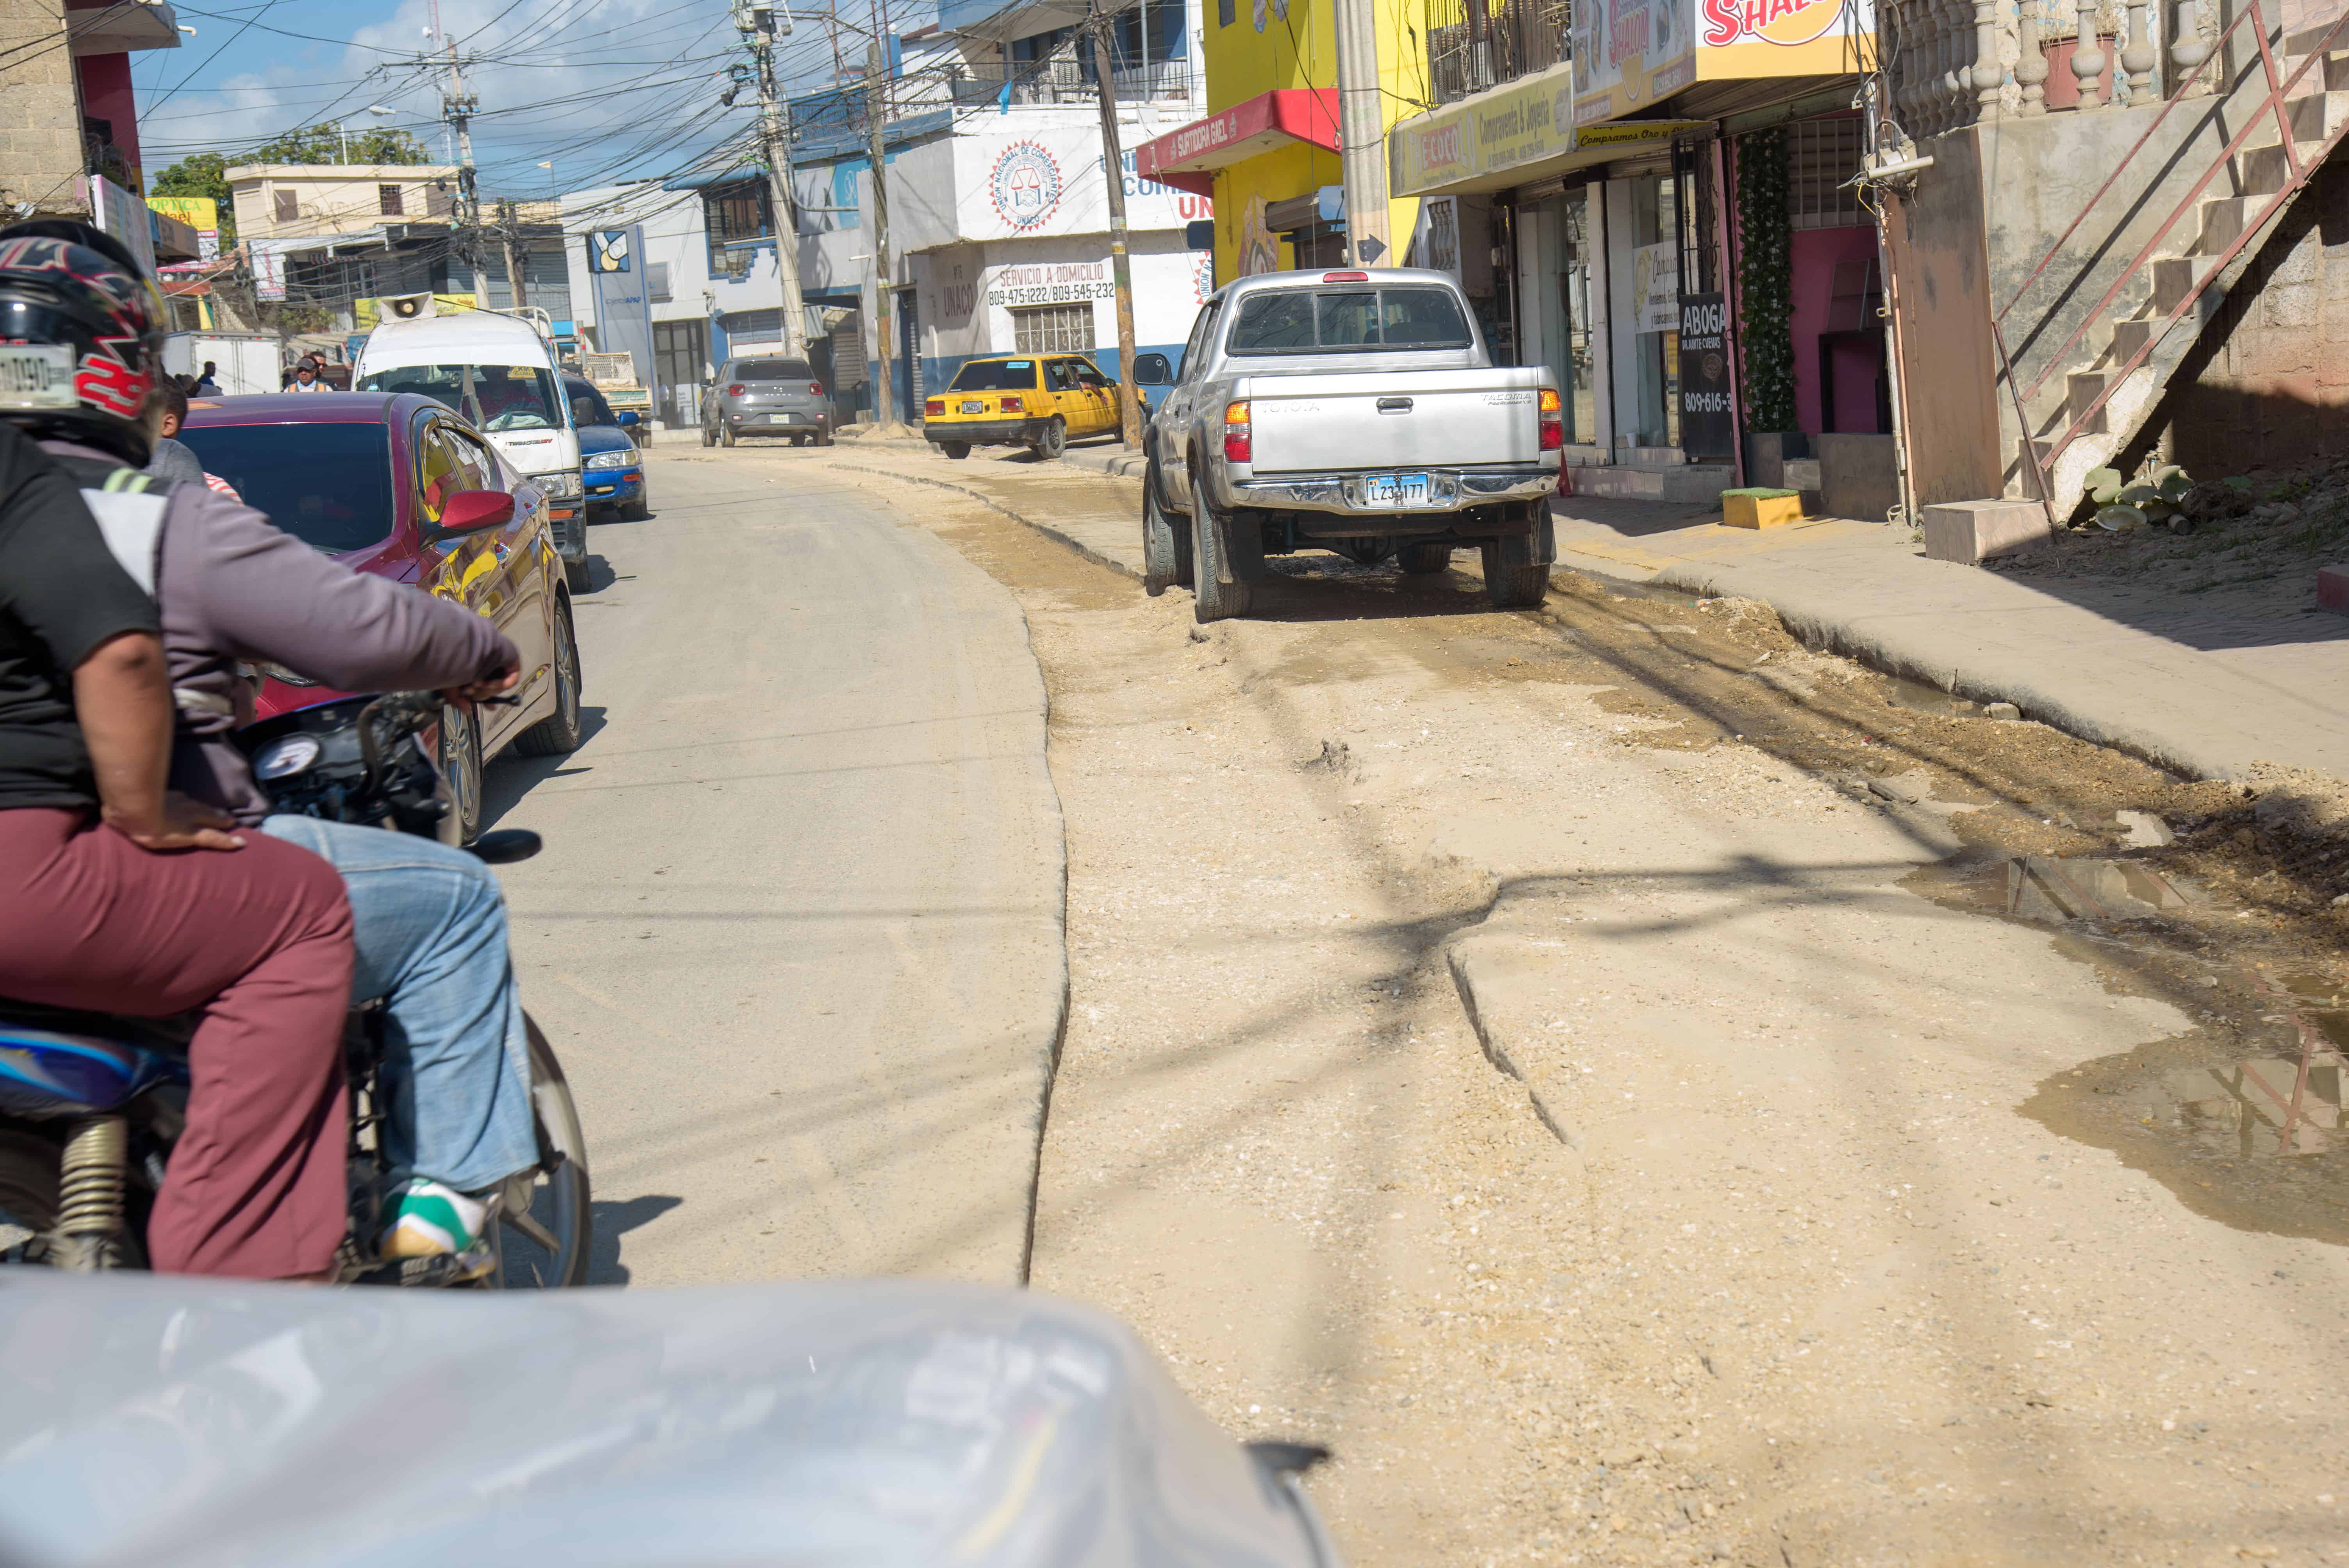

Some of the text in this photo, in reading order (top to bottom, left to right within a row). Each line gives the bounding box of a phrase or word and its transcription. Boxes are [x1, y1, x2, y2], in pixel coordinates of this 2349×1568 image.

[1702, 0, 1826, 47] SHAL
[1609, 0, 1650, 69] SHALOM
[1479, 103, 1518, 151] Compraventa
[1519, 99, 1525, 134] &
[1178, 118, 1228, 157] SURTIDORA GAEL
[1580, 133, 1638, 146] Compramos
[1641, 129, 1659, 139] Oro
[995, 146, 1057, 211] UNION NACIONAL DE COMERCIANTES
[1123, 177, 1191, 196] COM
[150, 199, 201, 211] OPTICA
[164, 212, 191, 222] ael
[1017, 215, 1040, 225] UNACO
[1000, 264, 1104, 287] SERVICIO A DOMICILIO
[1200, 273, 1210, 297] UNION
[944, 283, 973, 317] UNACO
[1702, 337, 1721, 349] CUEVAS
[1259, 401, 1320, 413] TOYOTA
[1480, 393, 1531, 401] TACOMA
